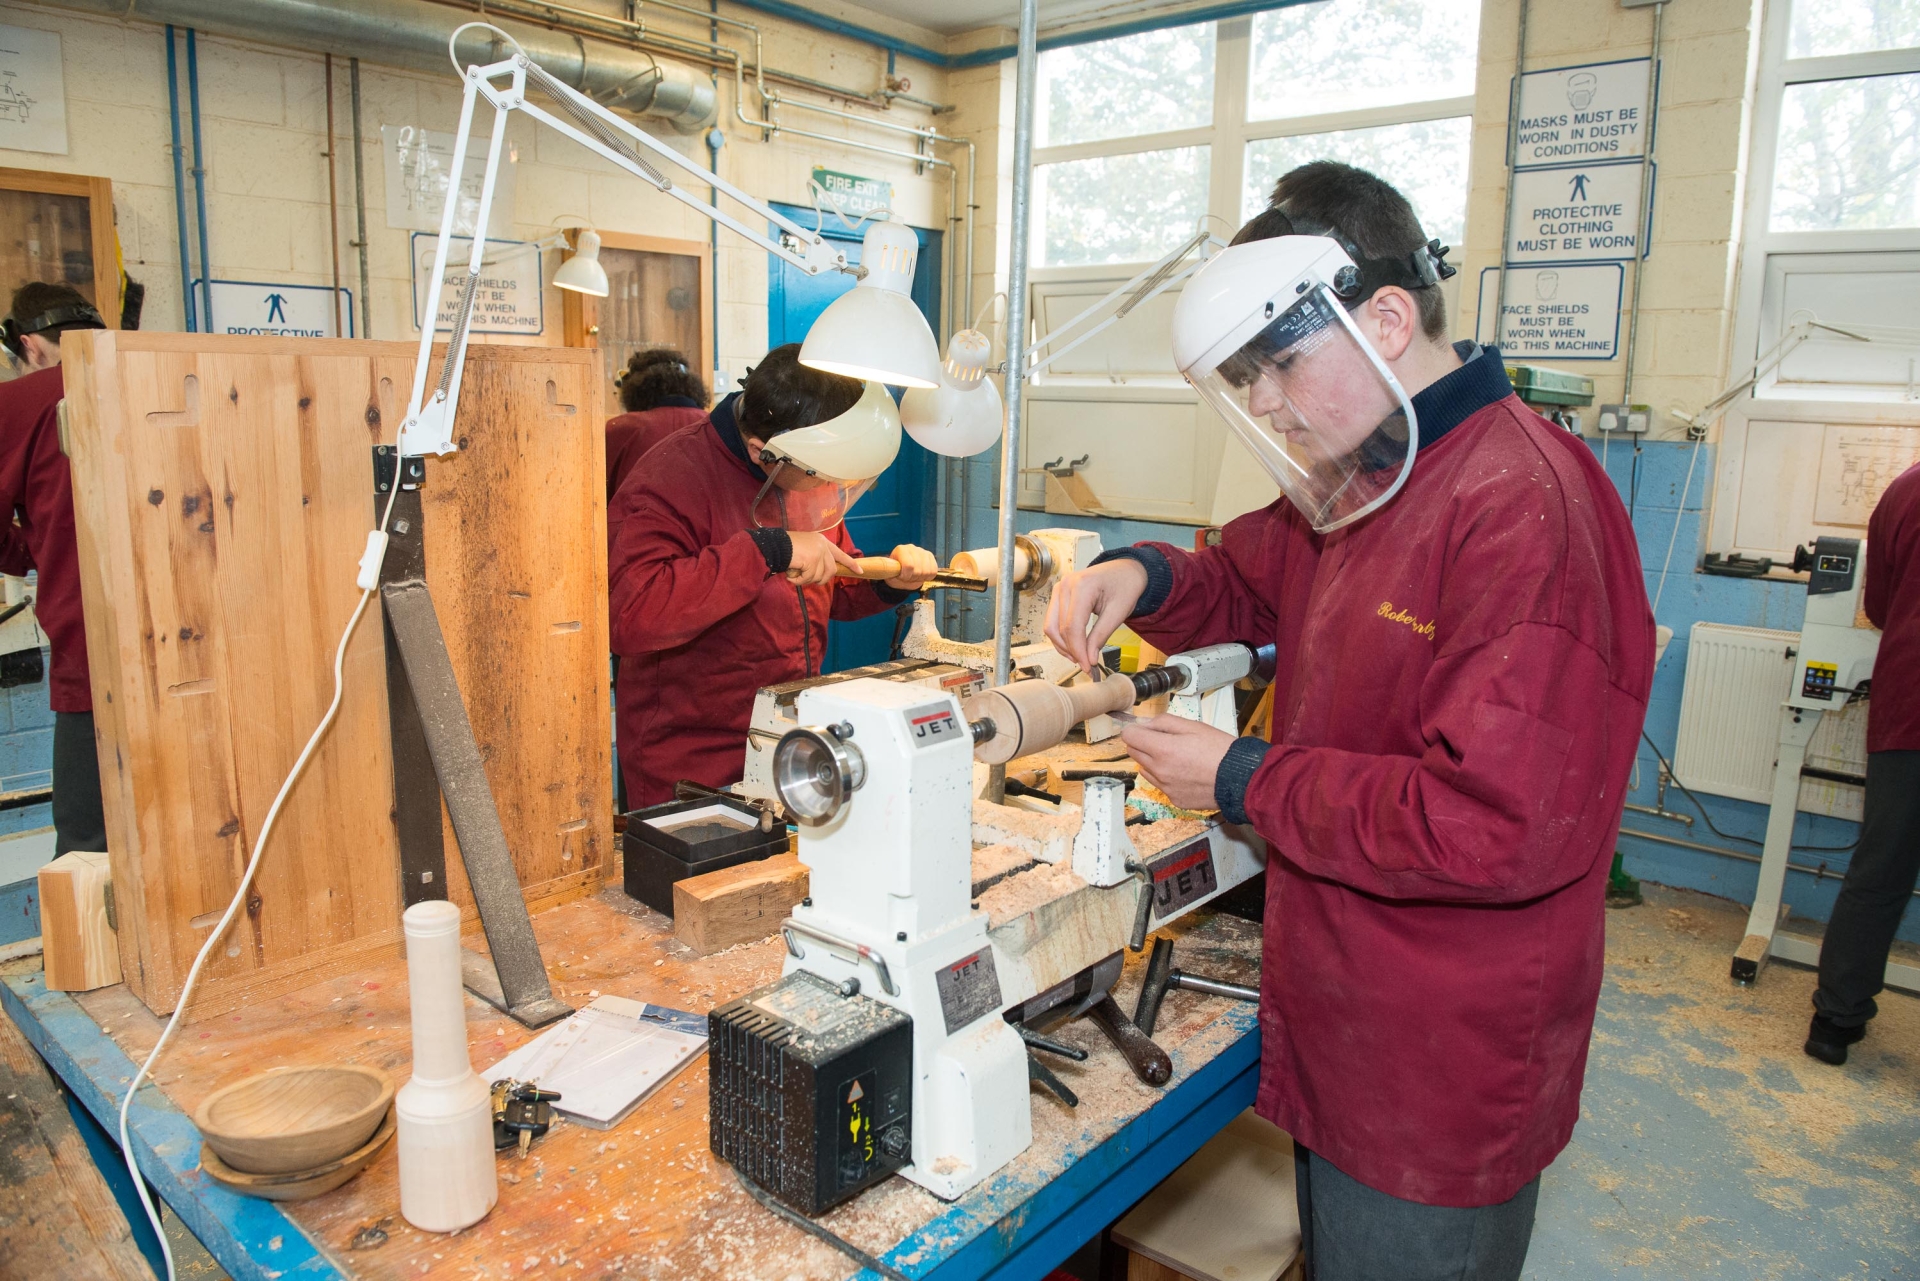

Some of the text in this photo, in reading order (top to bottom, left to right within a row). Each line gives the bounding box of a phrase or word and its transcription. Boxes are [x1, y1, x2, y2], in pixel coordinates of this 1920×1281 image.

[1520, 107, 1639, 130] MASKS MUST BE
[1519, 122, 1638, 145] WORN IN DUSTY
[1533, 139, 1619, 158] CONDITIONS
[825, 174, 879, 197] FIRE EXIT
[1532, 203, 1623, 220] PROTECTIVE
[1539, 220, 1614, 236] CLOTHING
[1517, 235, 1636, 252] MUST BE WORN
[442, 276, 466, 286] ACE
[491, 291, 506, 301] BE
[484, 303, 516, 313] WHEN
[1502, 304, 1590, 315] FACE SHIELDS
[491, 315, 539, 327] MACHINE
[1519, 316, 1575, 327] MUST BE
[1508, 328, 1586, 339] WORN WHEN
[1524, 341, 1550, 351] THIS
[1554, 341, 1612, 351] MACHINE
[951, 680, 986, 699] ET
[916, 718, 954, 738] JET
[1158, 859, 1210, 906] JET
[952, 959, 980, 982] JET
